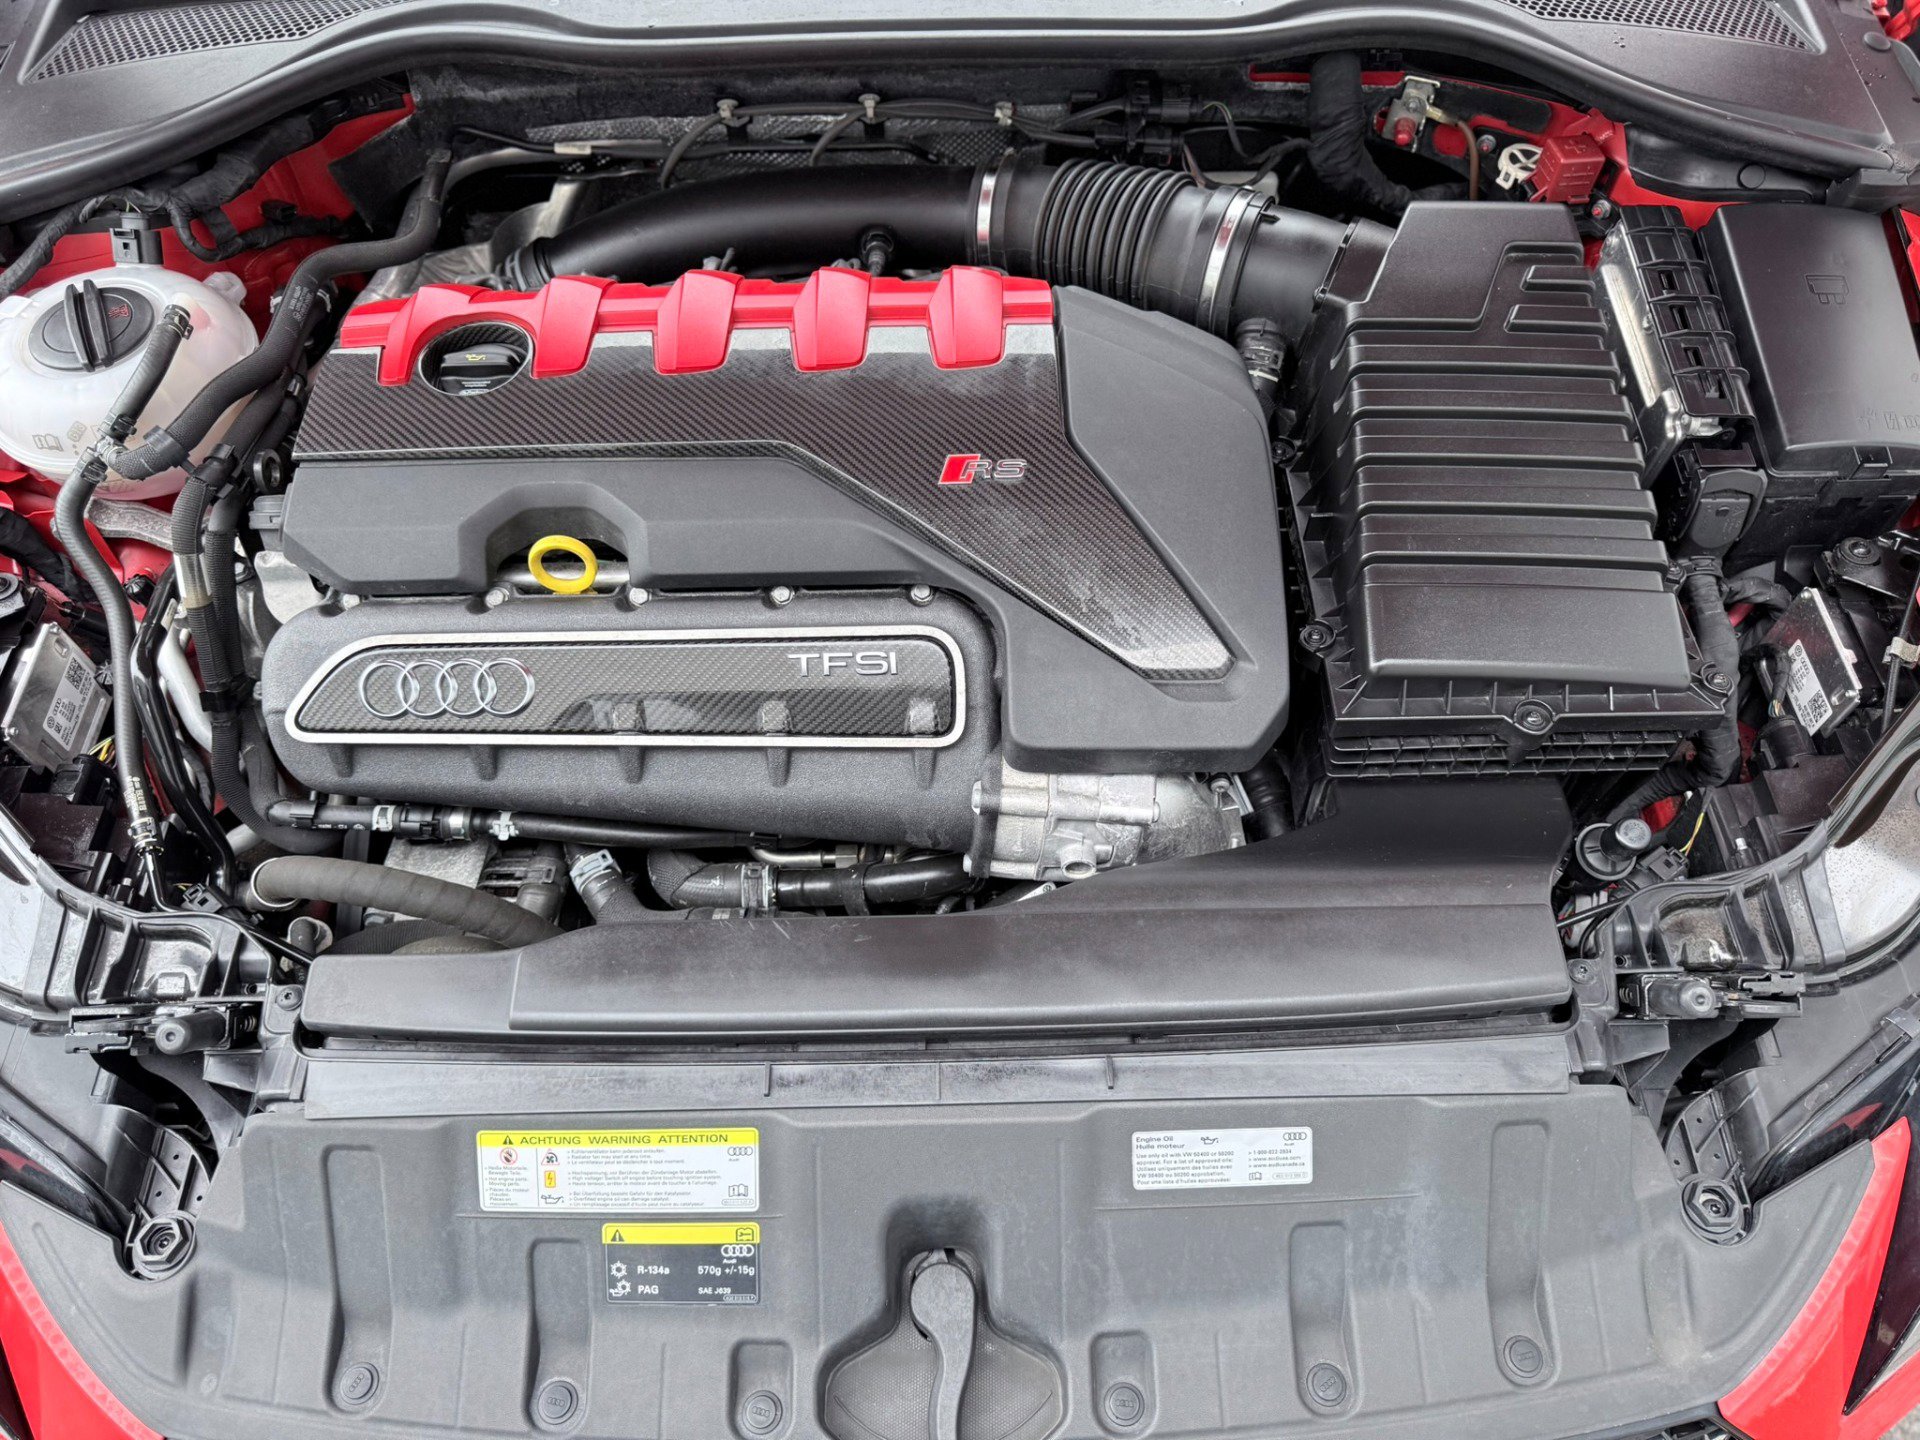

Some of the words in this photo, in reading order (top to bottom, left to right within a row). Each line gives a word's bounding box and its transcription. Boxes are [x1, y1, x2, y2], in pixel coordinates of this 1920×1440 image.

[957, 458, 1027, 480] RS
[787, 651, 897, 677] TFSI
[520, 1135, 581, 1145] ACHTUNG
[588, 1135, 651, 1144] WARNING
[658, 1134, 728, 1144] ATTENTION
[637, 1265, 670, 1275] R-134a
[697, 1265, 722, 1276] 570g
[724, 1265, 755, 1276] +/-15g
[637, 1285, 659, 1295] PAG
[698, 1287, 713, 1295] SAE
[714, 1287, 732, 1295] J639
